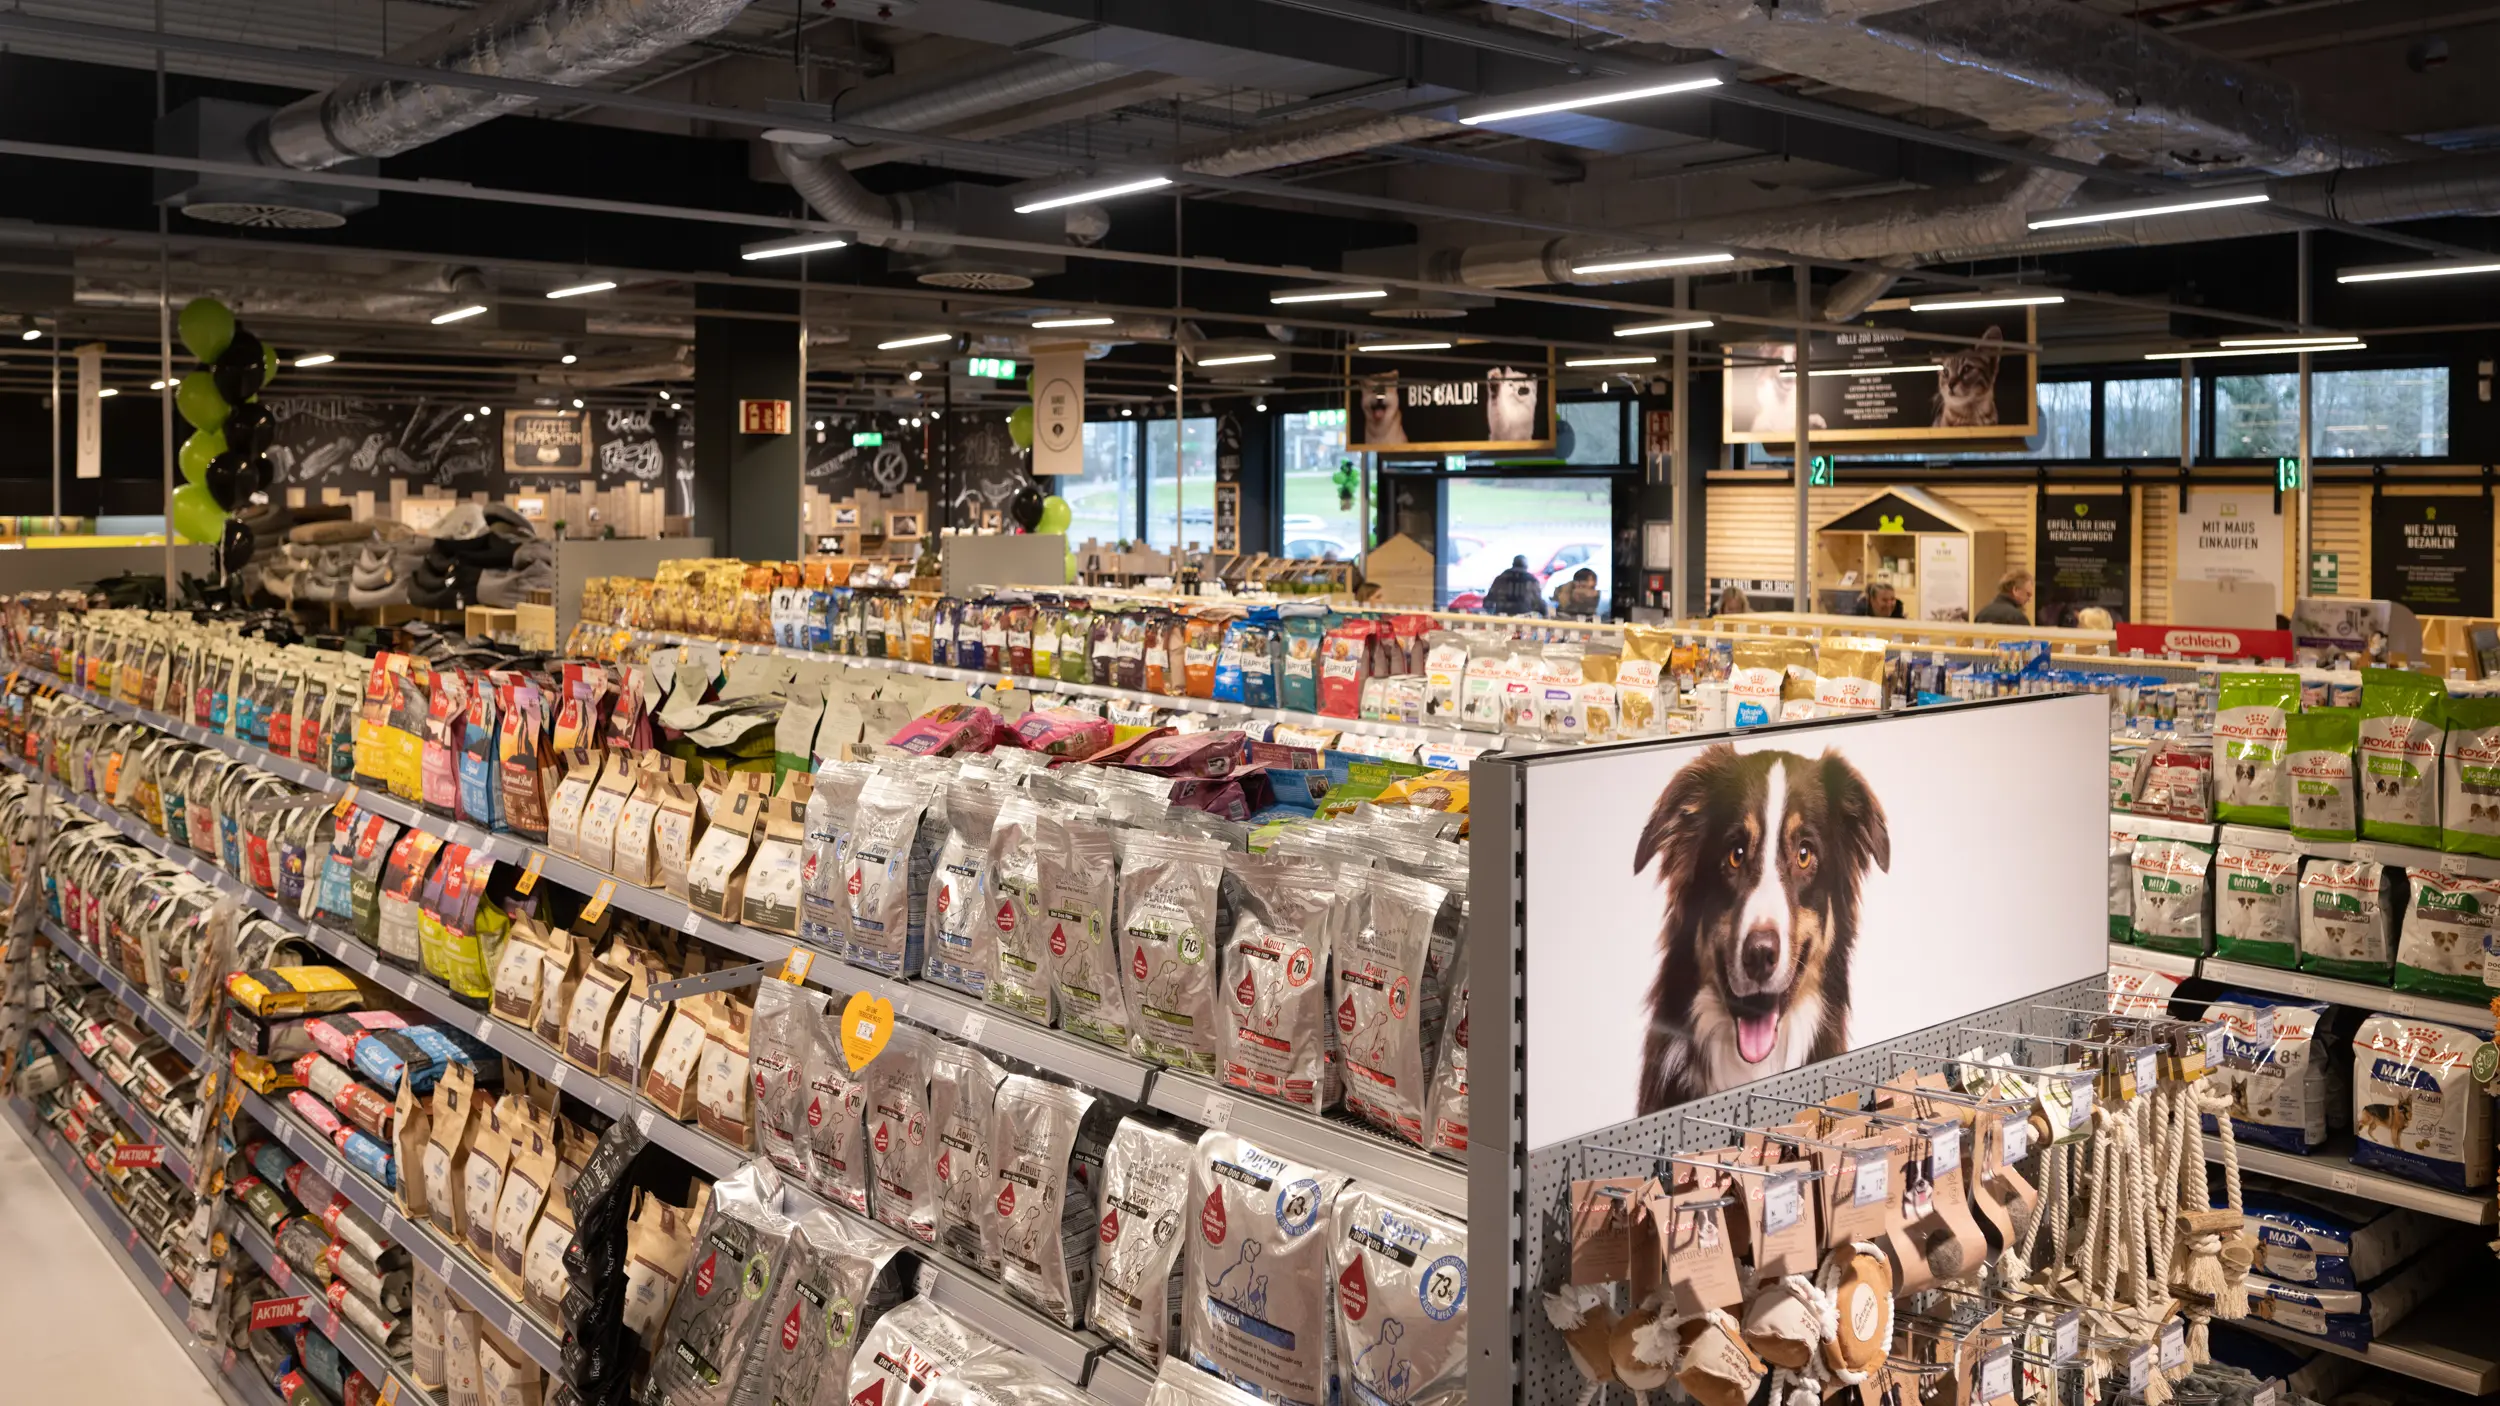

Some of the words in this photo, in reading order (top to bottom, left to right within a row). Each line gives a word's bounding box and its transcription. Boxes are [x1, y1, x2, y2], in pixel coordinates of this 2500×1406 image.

[1408, 385, 1432, 407] BIS
[1434, 382, 1479, 405] BALD!
[1815, 456, 1826, 484] 2
[2286, 460, 2296, 488] 3
[2047, 518, 2074, 531] ERFÜLL
[2076, 520, 2092, 532] TIER
[2094, 520, 2117, 531] EINEN
[2202, 521, 2222, 534] MIT
[2224, 521, 2255, 534] MAUS
[2404, 524, 2420, 536] NIE
[2422, 524, 2435, 536] ZU
[2437, 524, 2459, 536] VIEL
[2050, 531, 2114, 542] HERZENSWUNSCH
[2198, 536, 2259, 550] EINKAUFEN
[2406, 536, 2455, 549] BEZAHLEN
[2173, 634, 2233, 650] schleich
[1822, 695, 1847, 704] ROYAL
[1849, 697, 1876, 706] CANIN
[2222, 724, 2253, 736] ROYAL
[2363, 735, 2397, 749] ROYAL
[2399, 740, 2432, 752] CANIN
[2457, 746, 2494, 760] ROYAL
[2291, 766, 2318, 775] ROYAL
[2319, 767, 2345, 776] CANIN
[871, 844, 891, 856] PUPPY
[963, 856, 980, 868] PUPPY
[2139, 857, 2168, 872] ROYAL
[2223, 857, 2254, 868] ROYAL
[2148, 878, 2171, 891] MINI
[2233, 876, 2259, 889] MINI
[2275, 883, 2292, 895] 8+
[2315, 893, 2341, 906] MINI
[2342, 913, 2369, 924] Ageing
[2456, 912, 2492, 925] Ageing
[1263, 937, 1287, 952] ADULT
[1293, 959, 1307, 975] 70%
[1364, 961, 1388, 980] ADULT
[2280, 1050, 2301, 1064] 8+
[2380, 1063, 2419, 1081] MAXI
[2417, 1093, 2442, 1105] Adult
[955, 1128, 977, 1143] ADULT
[117, 1149, 151, 1161] AKTION
[1893, 1141, 1924, 1157] nature
[1019, 1162, 1042, 1179] ADULT
[1214, 1162, 1228, 1175] DRY
[1227, 1168, 1240, 1180] DOG
[1240, 1172, 1257, 1186] FOOD
[1293, 1222, 1311, 1236] MEAT
[1379, 1211, 1431, 1252] PUPPY
[1353, 1230, 1366, 1243] DRY
[1381, 1243, 1399, 1259] FOOD
[2268, 1230, 2298, 1245] MAXI
[1671, 1248, 1702, 1264] nature
[1704, 1243, 1725, 1259] play
[2292, 1252, 2312, 1260] Adult
[1430, 1257, 1467, 1288] FRISCHFLEISCH
[1349, 1280, 1360, 1290] aus
[1430, 1272, 1455, 1302] 73%
[2277, 1286, 2309, 1301] MAXI
[255, 1303, 294, 1321] AKTION
[1343, 1297, 1361, 1312] garung
[1420, 1294, 1437, 1318] FRESH
[1437, 1306, 1454, 1320] MEAT
[1209, 1303, 1240, 1327] CHICKEN
[2301, 1307, 2320, 1318] Adult
[2347, 1331, 2356, 1340] kg
[677, 1343, 696, 1365] CHICKEN
[591, 1356, 601, 1379] Beef
[878, 1357, 893, 1370] DRY
[901, 1345, 942, 1383] ADULT
